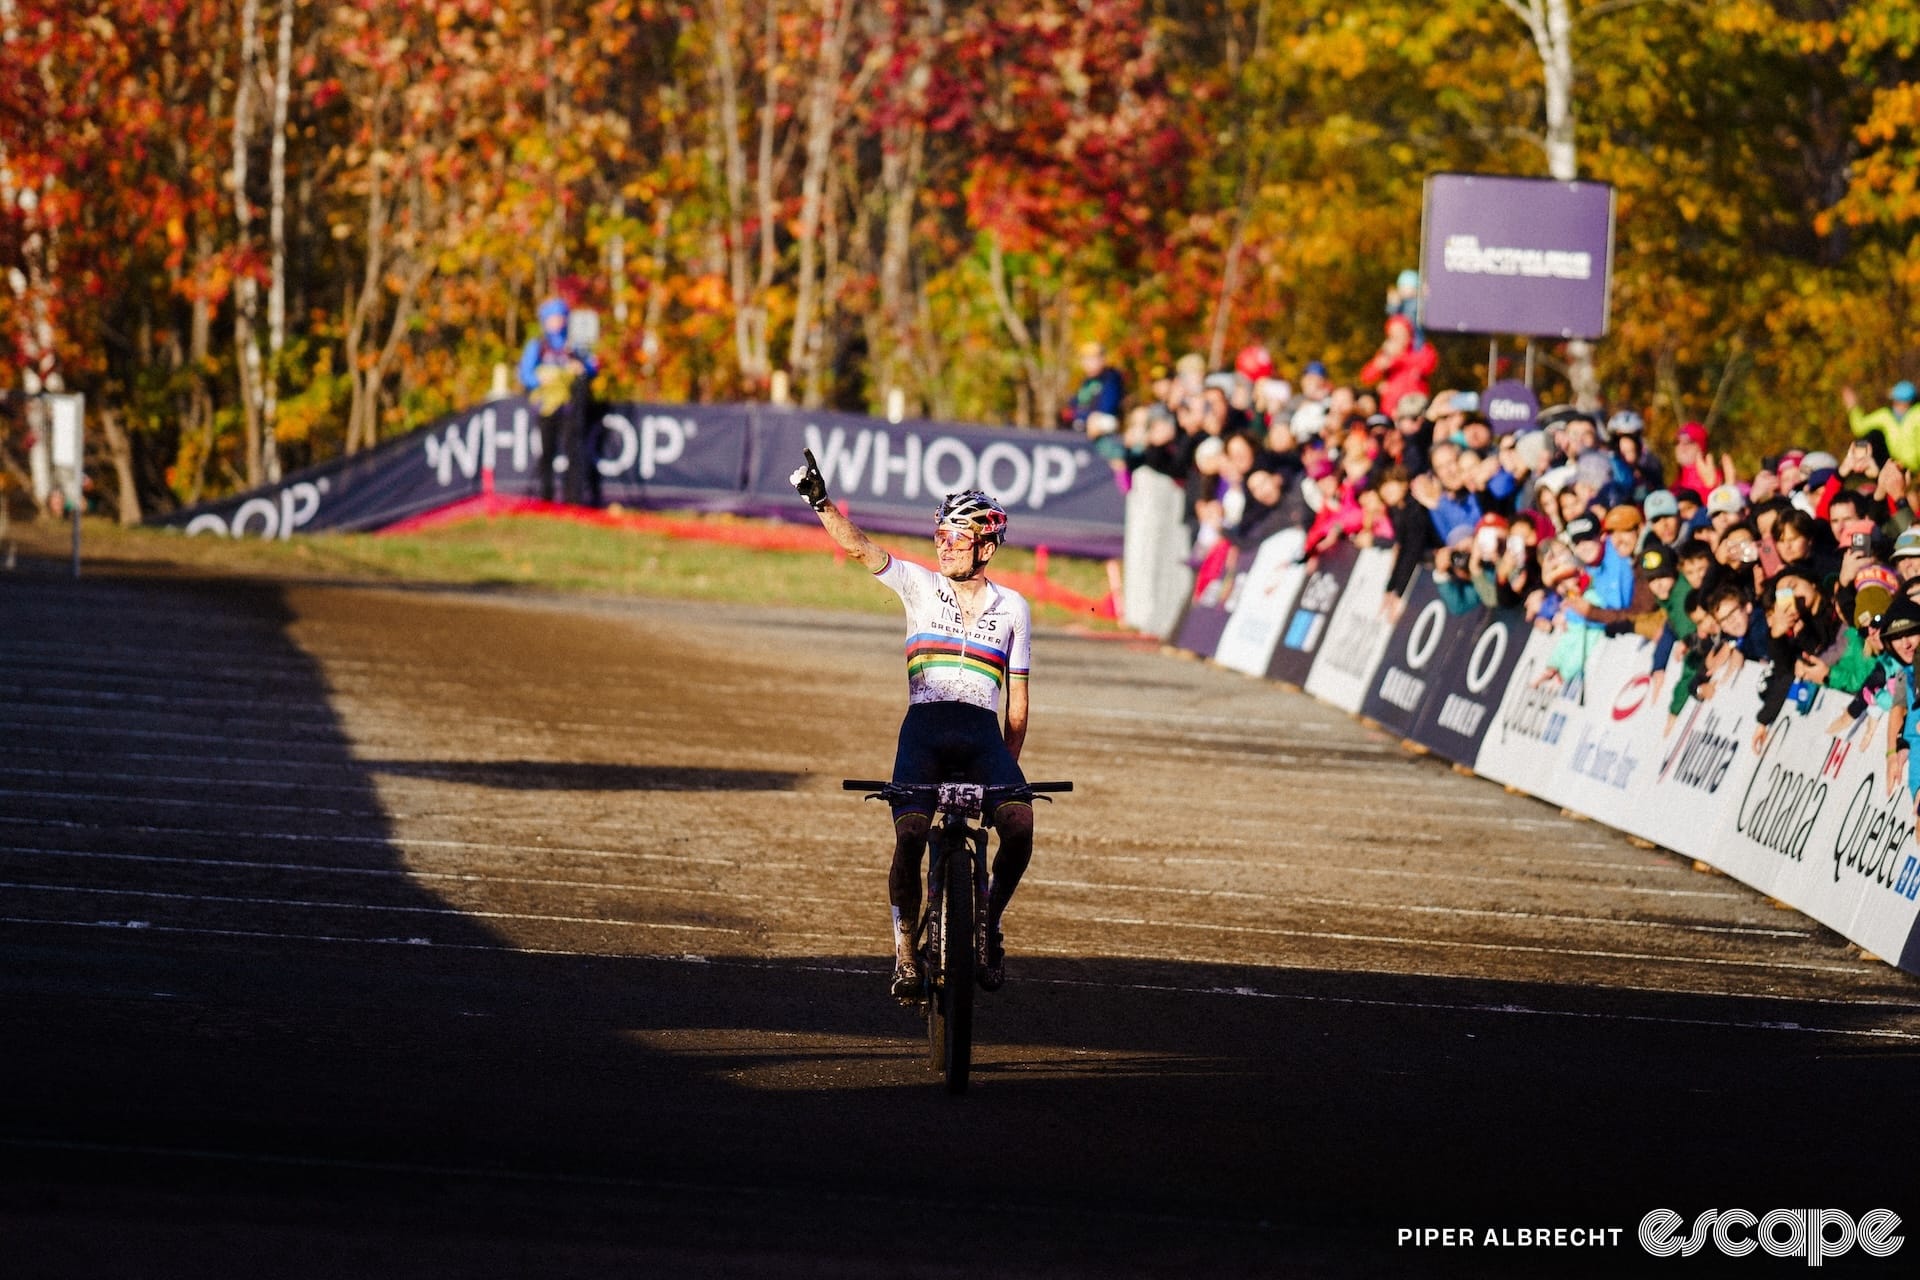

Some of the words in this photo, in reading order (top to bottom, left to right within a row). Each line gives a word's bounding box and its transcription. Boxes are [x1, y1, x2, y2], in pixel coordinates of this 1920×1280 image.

[805, 424, 1078, 510] WHOOP
[1737, 715, 1837, 862] Canada
[1833, 772, 1916, 889] Québec
